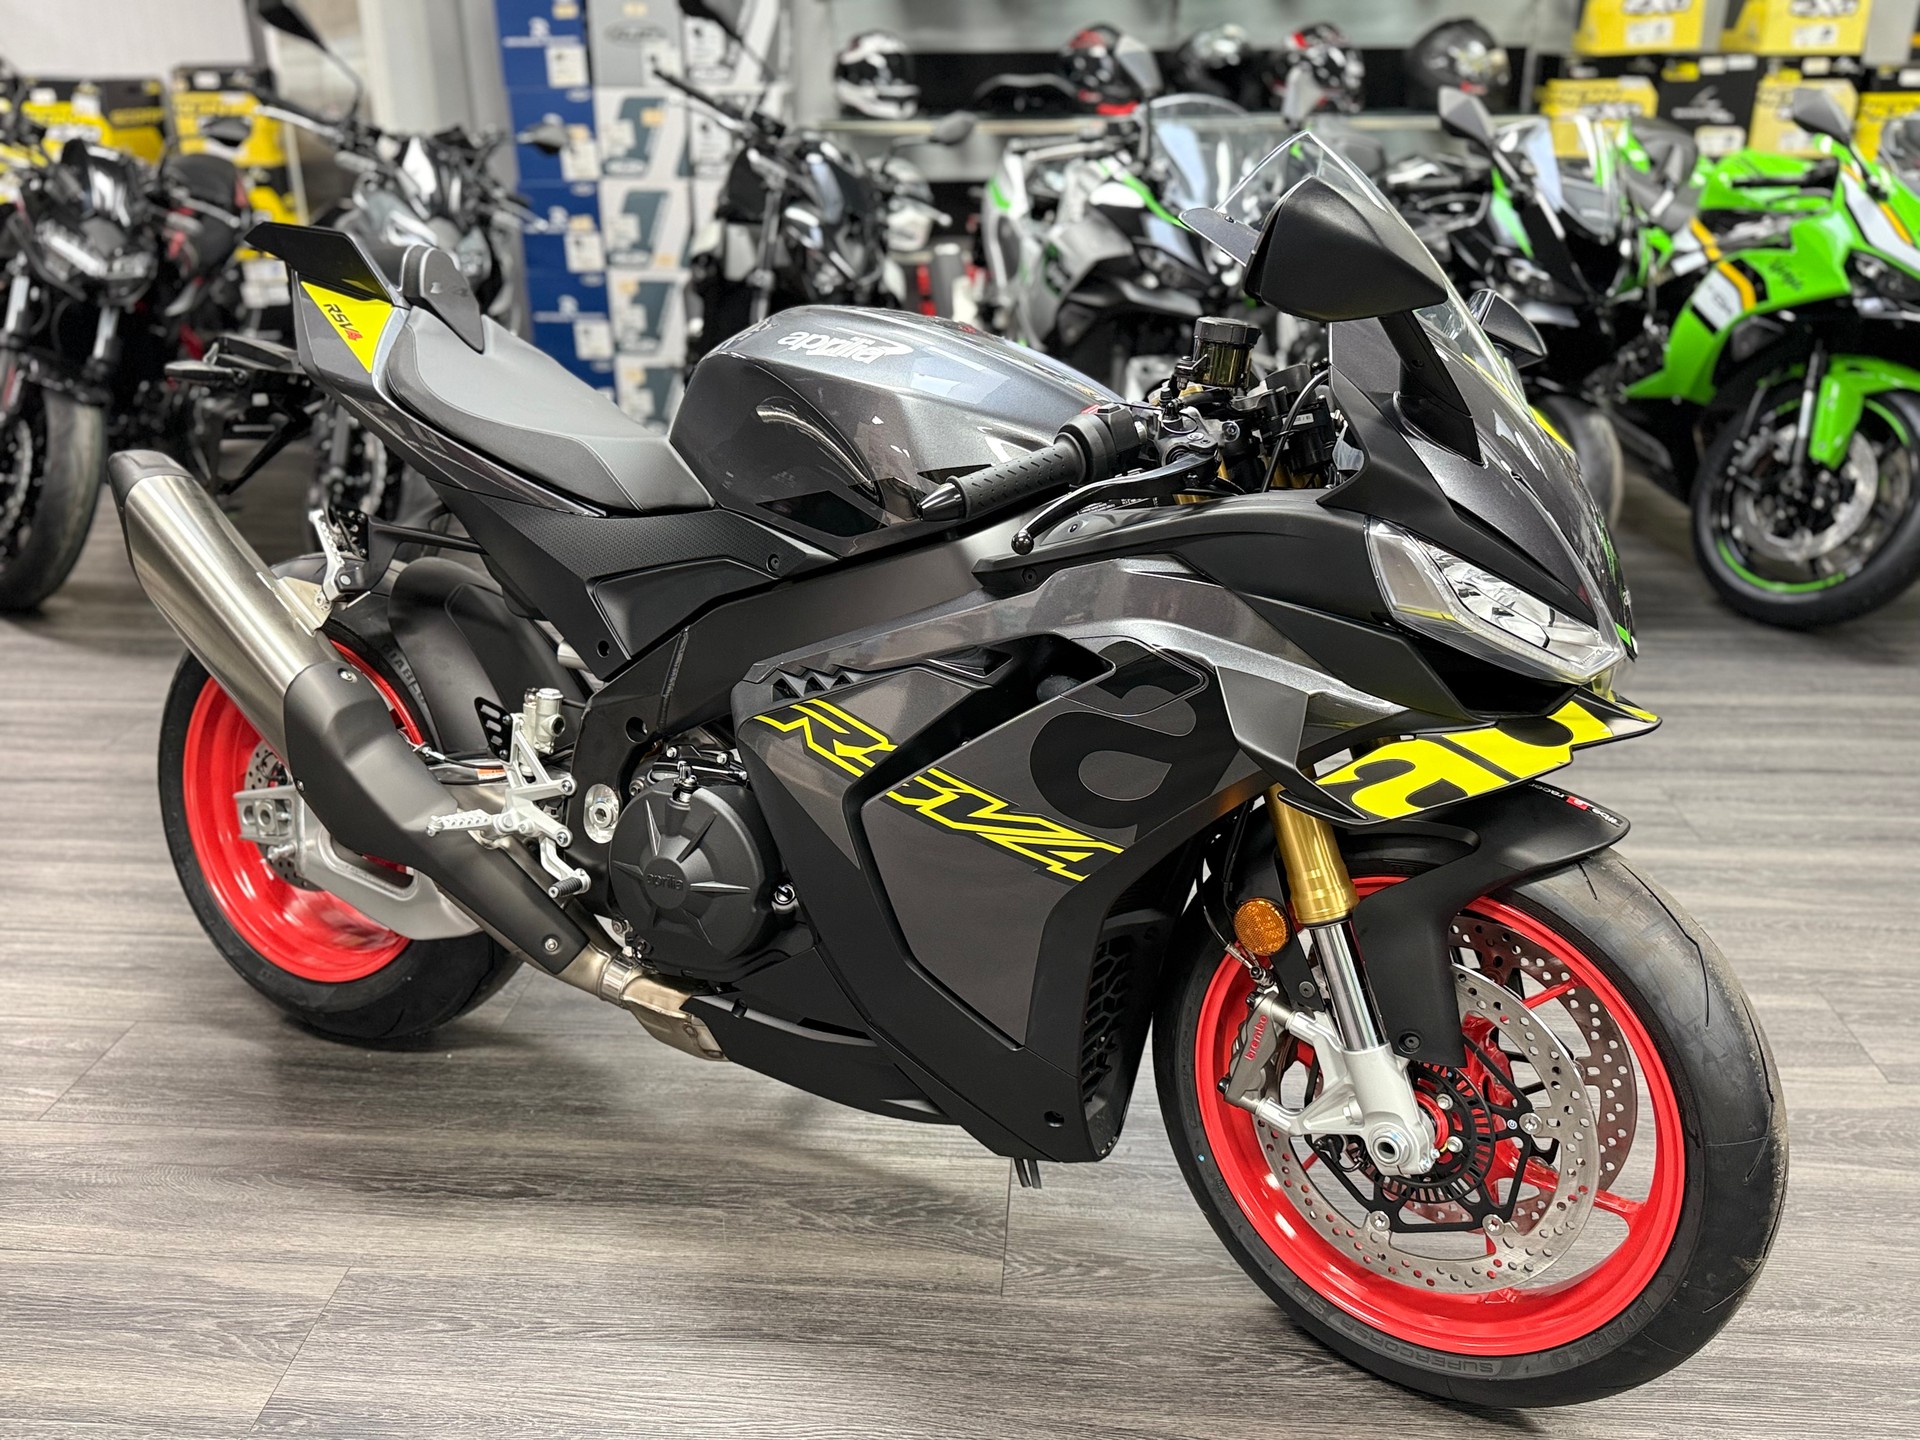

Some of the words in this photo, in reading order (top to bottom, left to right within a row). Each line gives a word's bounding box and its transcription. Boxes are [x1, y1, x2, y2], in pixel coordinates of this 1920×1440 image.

[323, 303, 363, 341] RSV4
[777, 331, 892, 364] aprilia
[1528, 783, 1565, 798] racer
[1244, 1014, 1269, 1062] brembo
[1293, 1287, 1328, 1316] SP
[1339, 1316, 1494, 1374] SUPERCORSA
